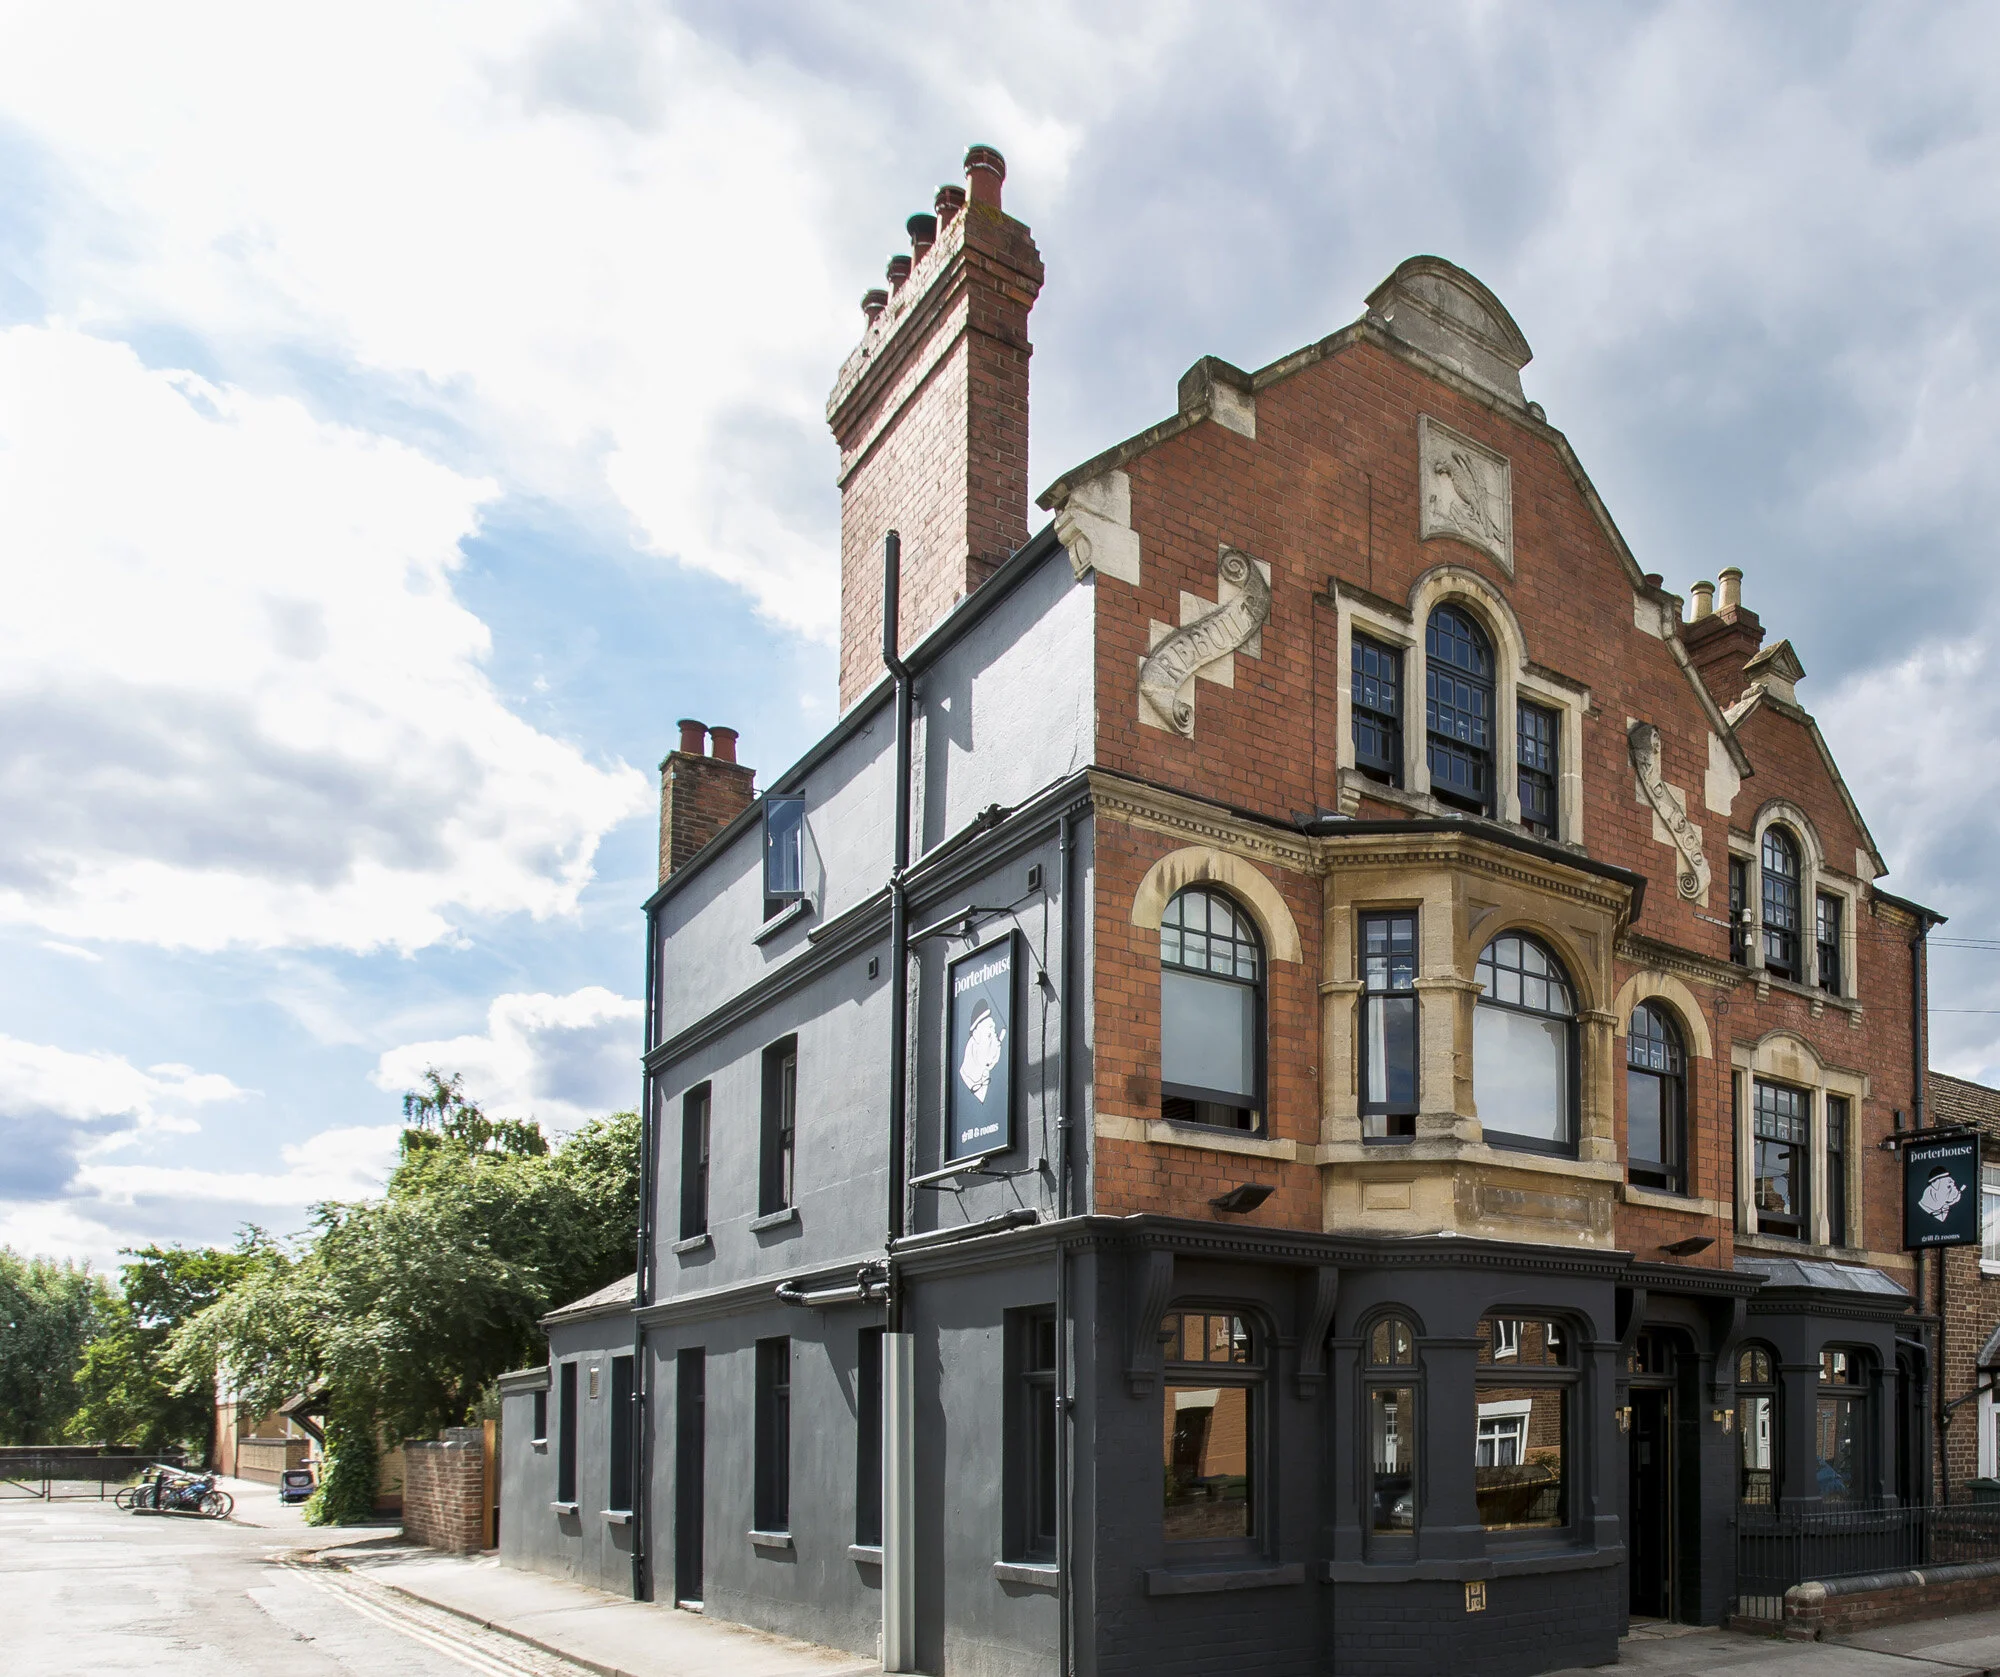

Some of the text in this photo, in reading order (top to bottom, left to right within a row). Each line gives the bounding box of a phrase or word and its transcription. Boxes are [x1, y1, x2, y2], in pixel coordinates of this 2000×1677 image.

[1158, 595, 1257, 683] REBUILT
[974, 1127, 980, 1138] &
[980, 1122, 999, 1136] rooms
[1910, 1145, 1973, 1163] porterhouse
